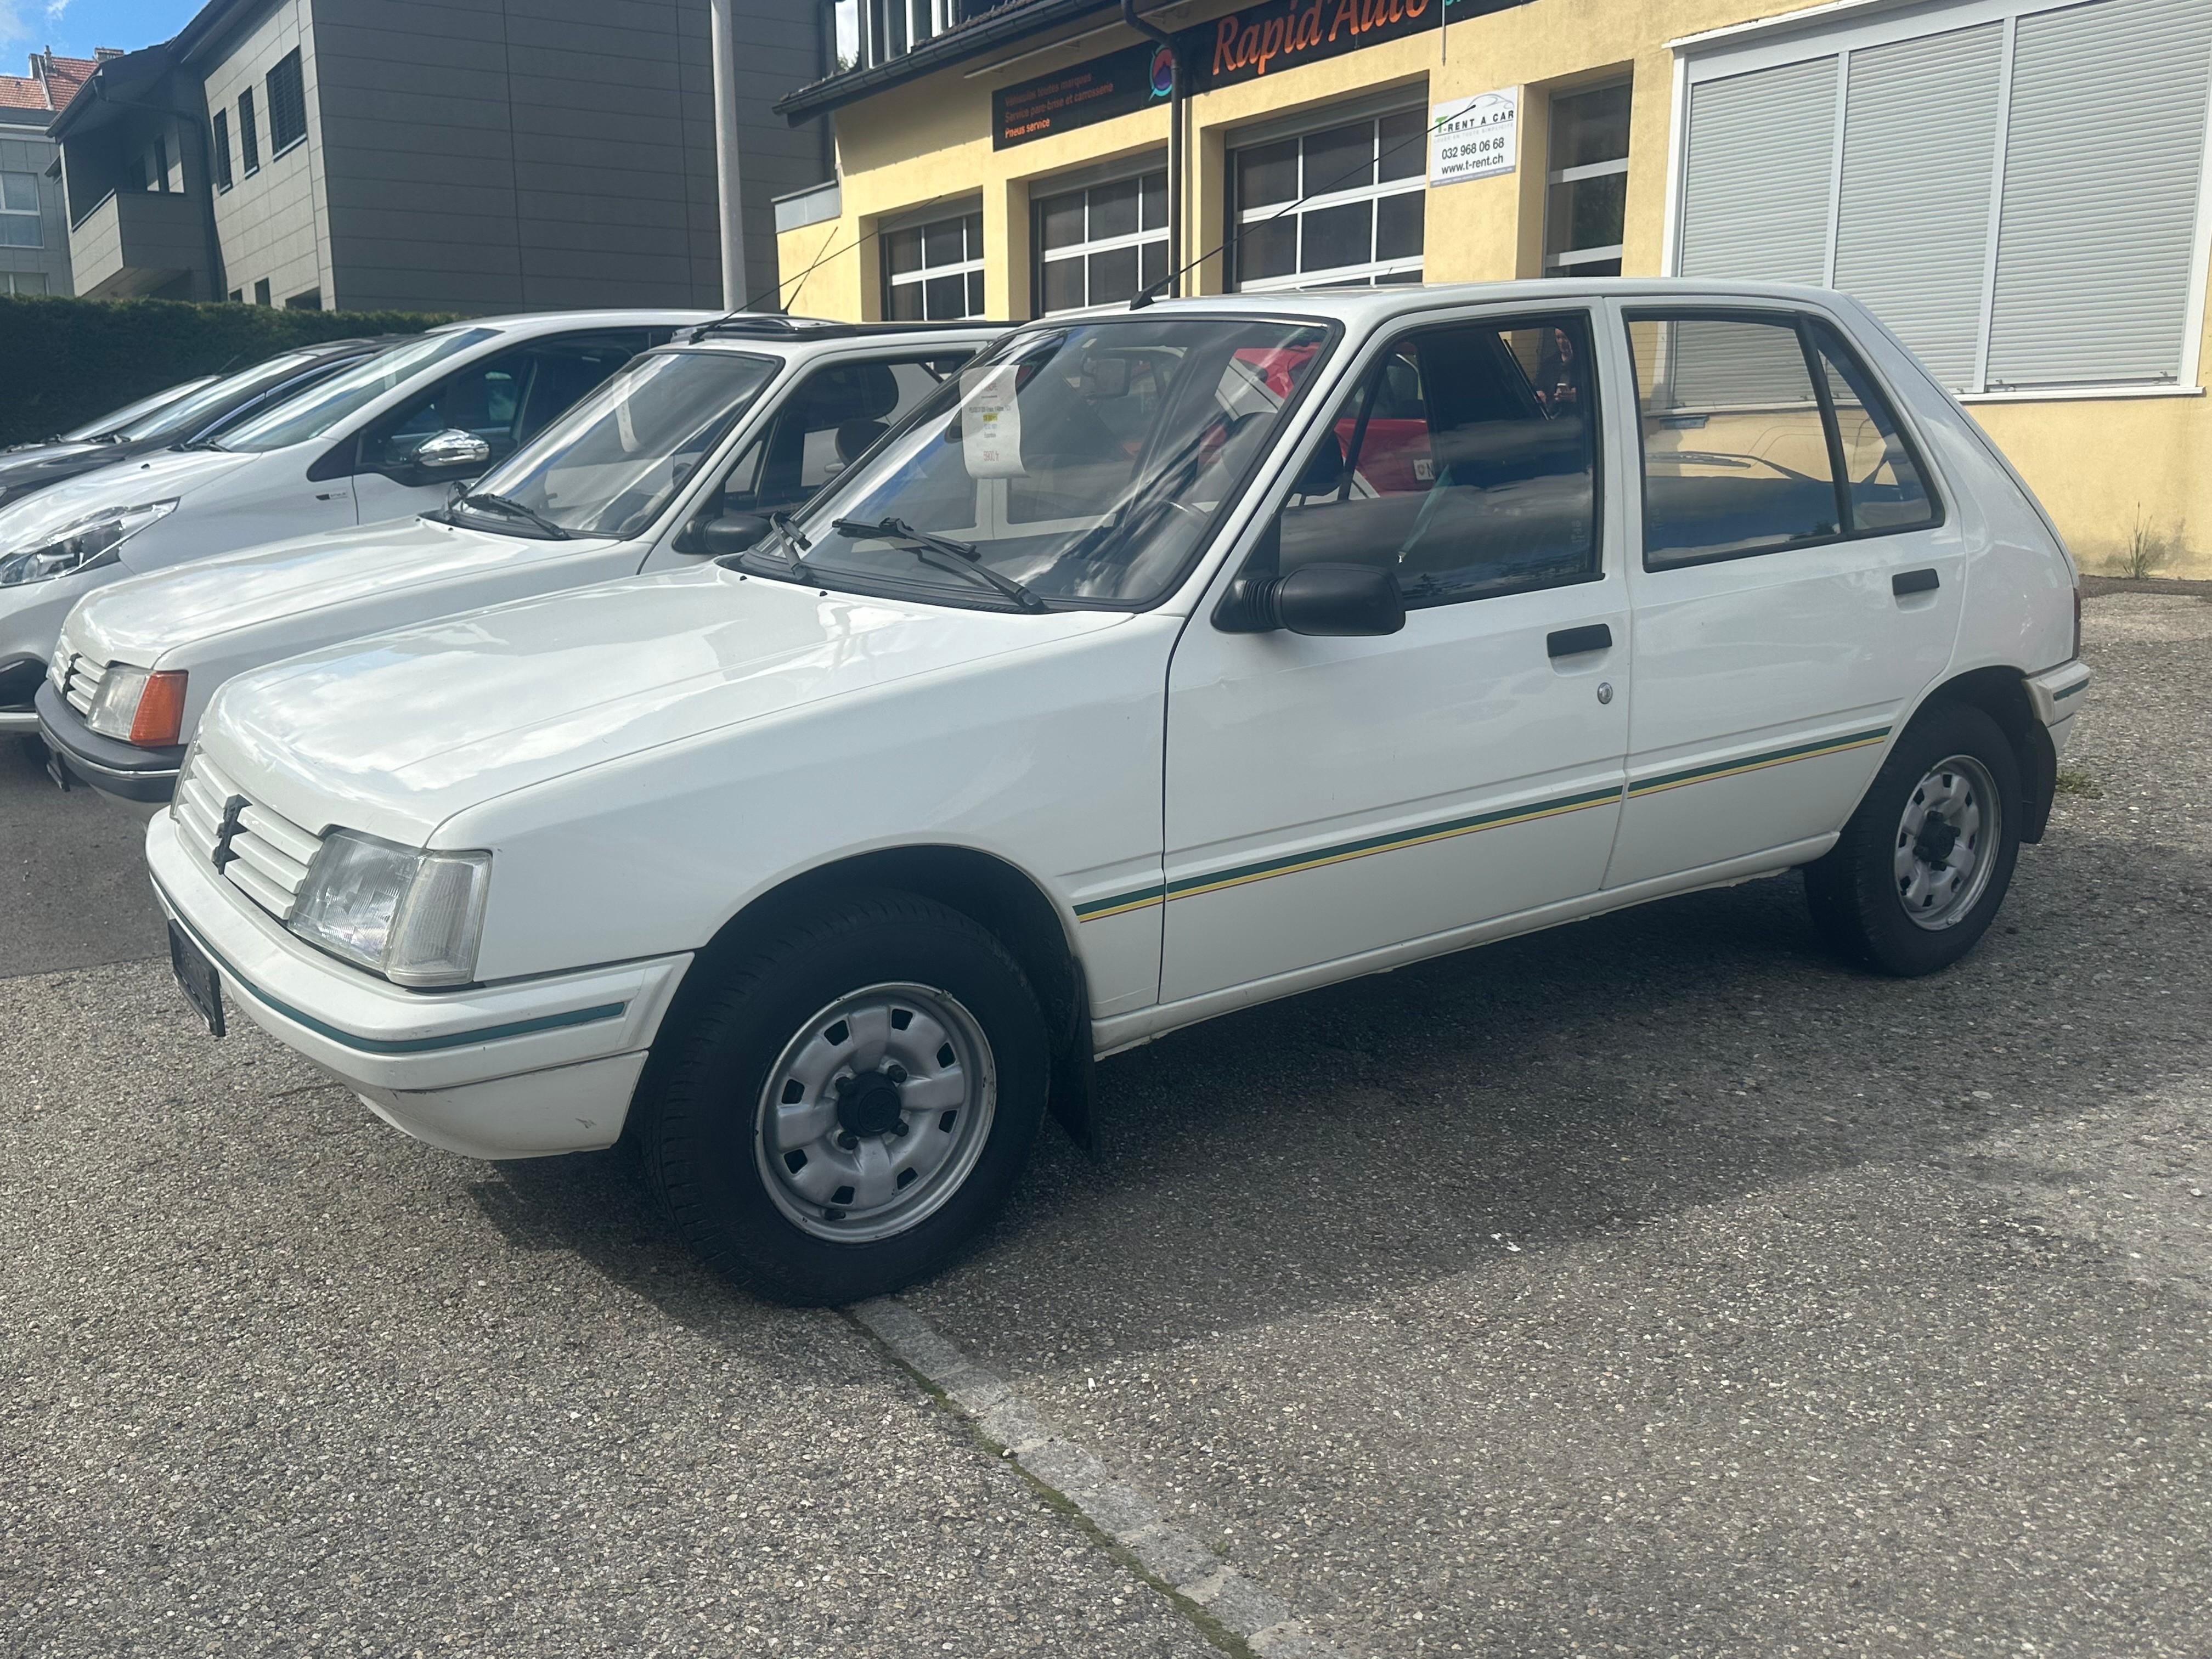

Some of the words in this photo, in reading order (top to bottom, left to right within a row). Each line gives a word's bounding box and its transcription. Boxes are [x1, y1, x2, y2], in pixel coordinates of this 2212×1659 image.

[1212, 0, 1427, 75] RapidAuto
[1005, 109, 1029, 123] Service
[1065, 94, 1073, 105] et
[1005, 126, 1026, 139] Pneus
[1026, 118, 1051, 132] service
[1435, 115, 1475, 133] T-RENT
[1481, 116, 1486, 125] A
[1493, 110, 1514, 122] CAR
[1442, 146, 1458, 160] 032
[1460, 143, 1477, 156] 968
[1479, 140, 1490, 152] 06
[1493, 137, 1505, 149] 68
[1442, 153, 1504, 175] www.t-rent.ch
